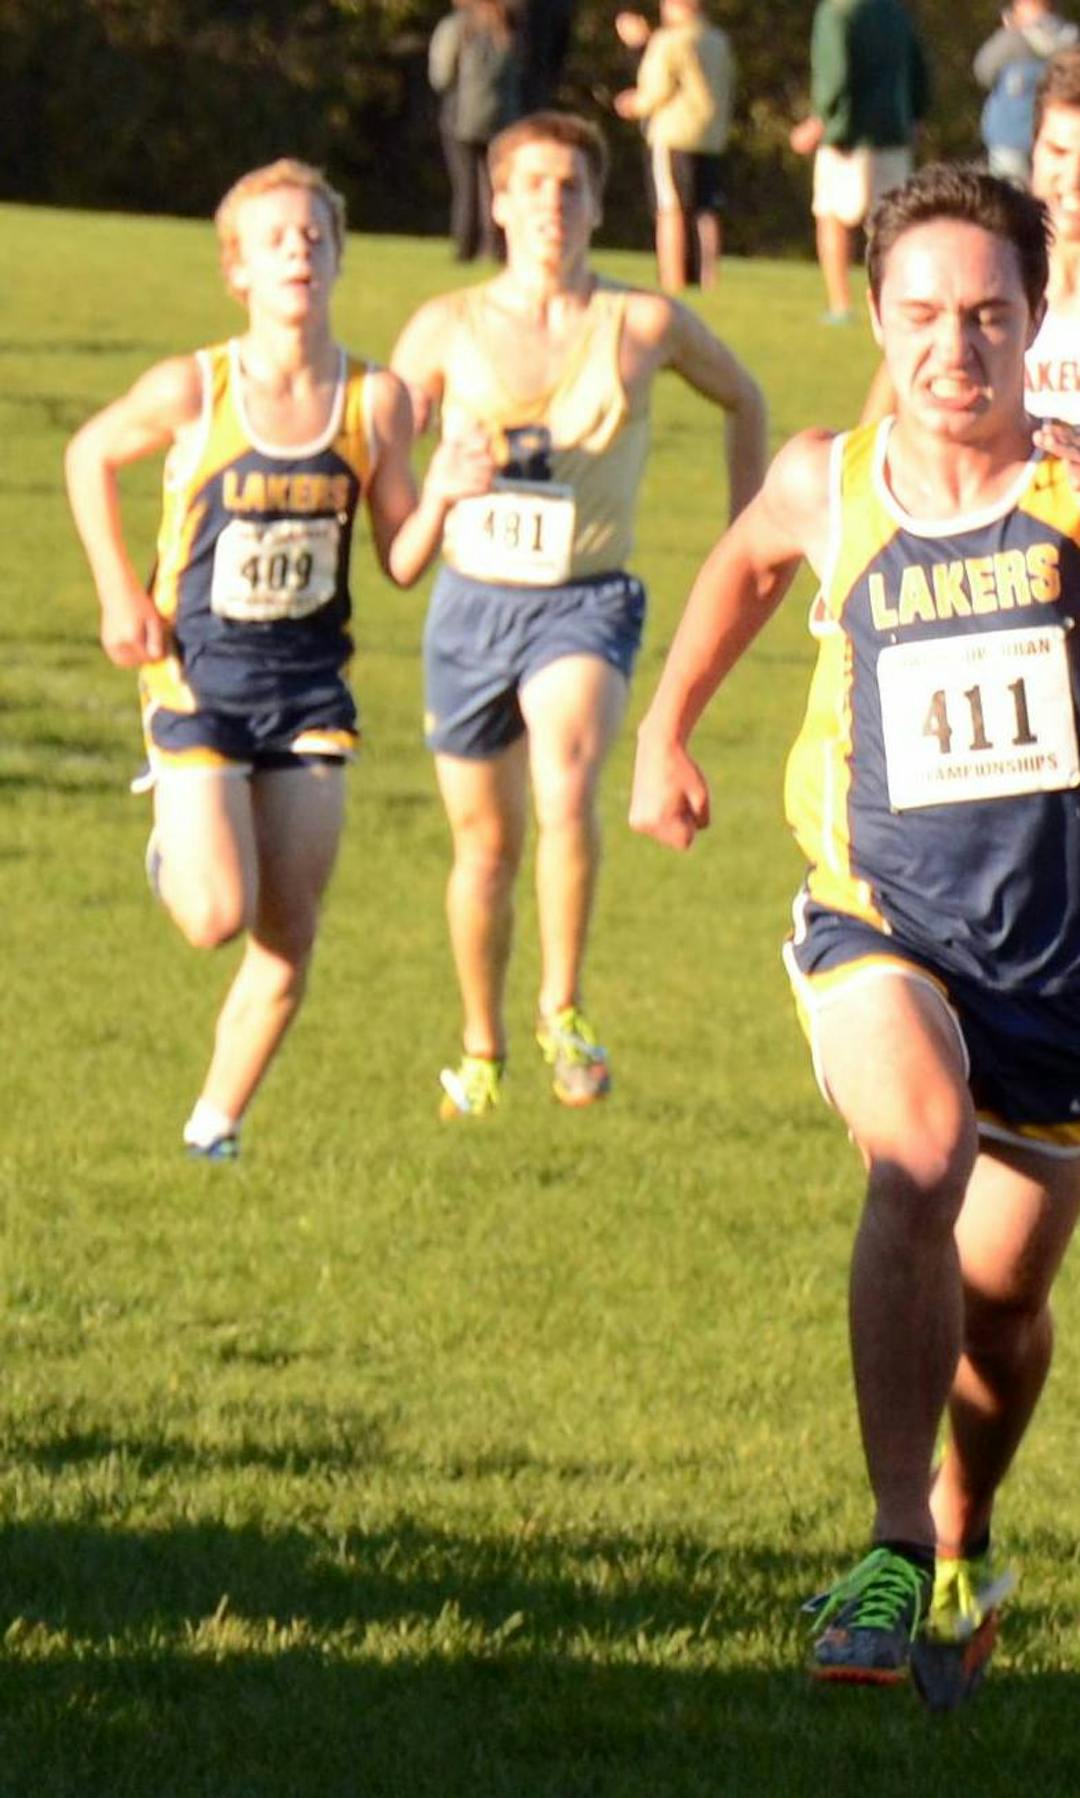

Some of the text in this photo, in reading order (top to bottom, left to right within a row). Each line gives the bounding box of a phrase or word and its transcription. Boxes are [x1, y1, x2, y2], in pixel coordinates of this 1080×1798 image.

[223, 471, 349, 512] LAKERS
[241, 552, 313, 590] 409
[868, 543, 1062, 631] LAKERS
[923, 677, 1038, 754] 411
